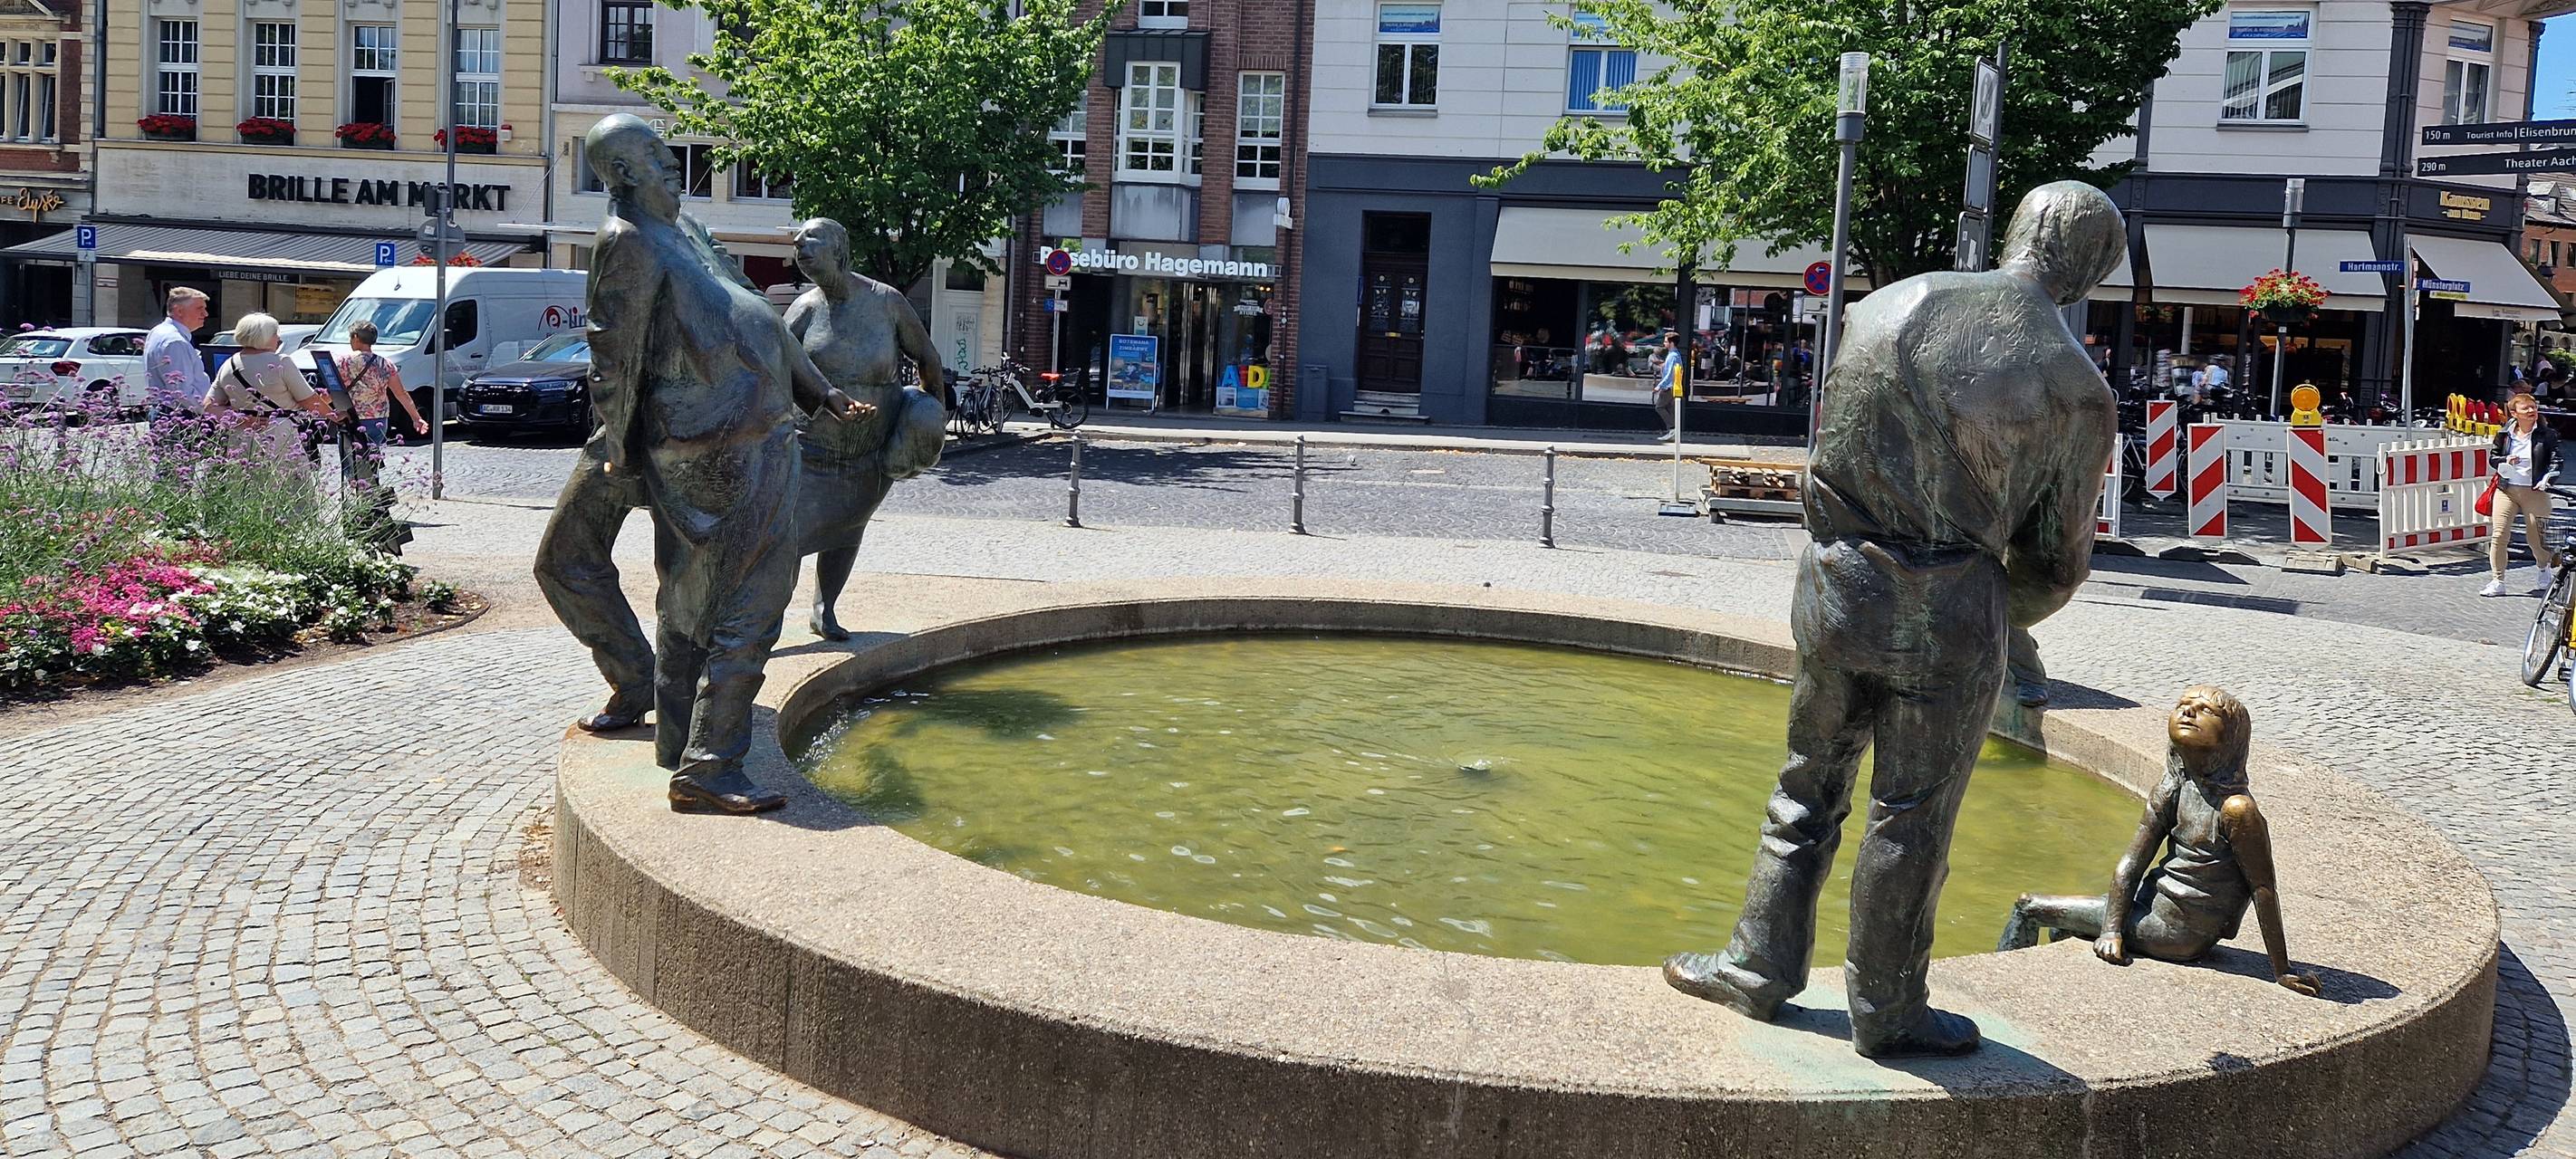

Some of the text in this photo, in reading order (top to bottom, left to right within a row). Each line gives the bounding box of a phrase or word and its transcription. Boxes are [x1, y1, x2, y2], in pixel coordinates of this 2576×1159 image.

[2426, 130, 2441, 139] 150
[2466, 131, 2494, 139] Tourist
[2496, 130, 2513, 139] Info
[2421, 162, 2437, 172] 290
[2438, 163, 2446, 171] m
[2504, 158, 2547, 168] Theater
[247, 173, 511, 212] BRILLE AM MRKT
[2439, 190, 2490, 210] Kaussen
[81, 228, 91, 245] P
[380, 245, 390, 263] P
[1040, 245, 1268, 277] Rsebüro Hagemann
[2348, 263, 2401, 271] Hartmannstr.
[218, 271, 240, 279] LIEBE
[240, 272, 262, 281] DEINE
[2422, 279, 2465, 292] Münsterplatz
